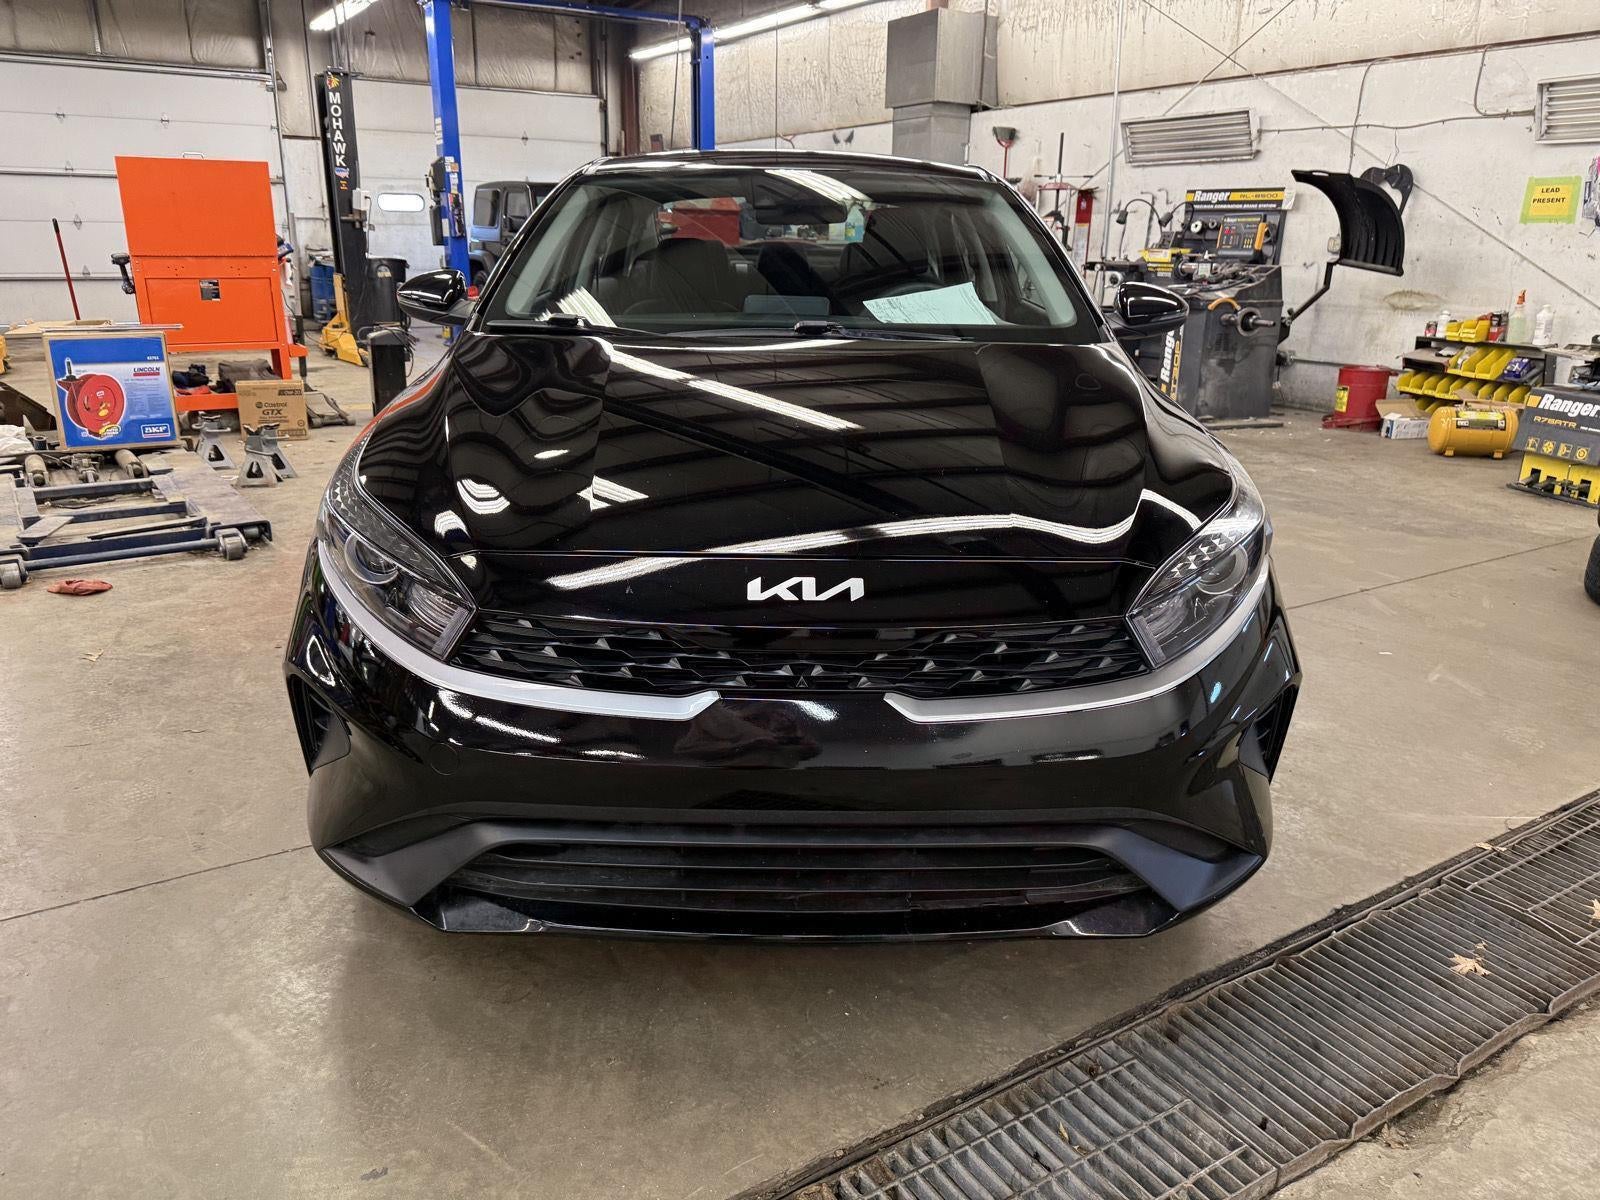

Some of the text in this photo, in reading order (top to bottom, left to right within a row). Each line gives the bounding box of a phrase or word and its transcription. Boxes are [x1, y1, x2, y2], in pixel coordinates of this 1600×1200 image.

[328, 91, 347, 167] MOHAWK
[1194, 190, 1230, 203] Ranger
[1538, 393, 1600, 418] Ranger
[144, 425, 167, 434] SKF
[747, 576, 864, 601] KIA
